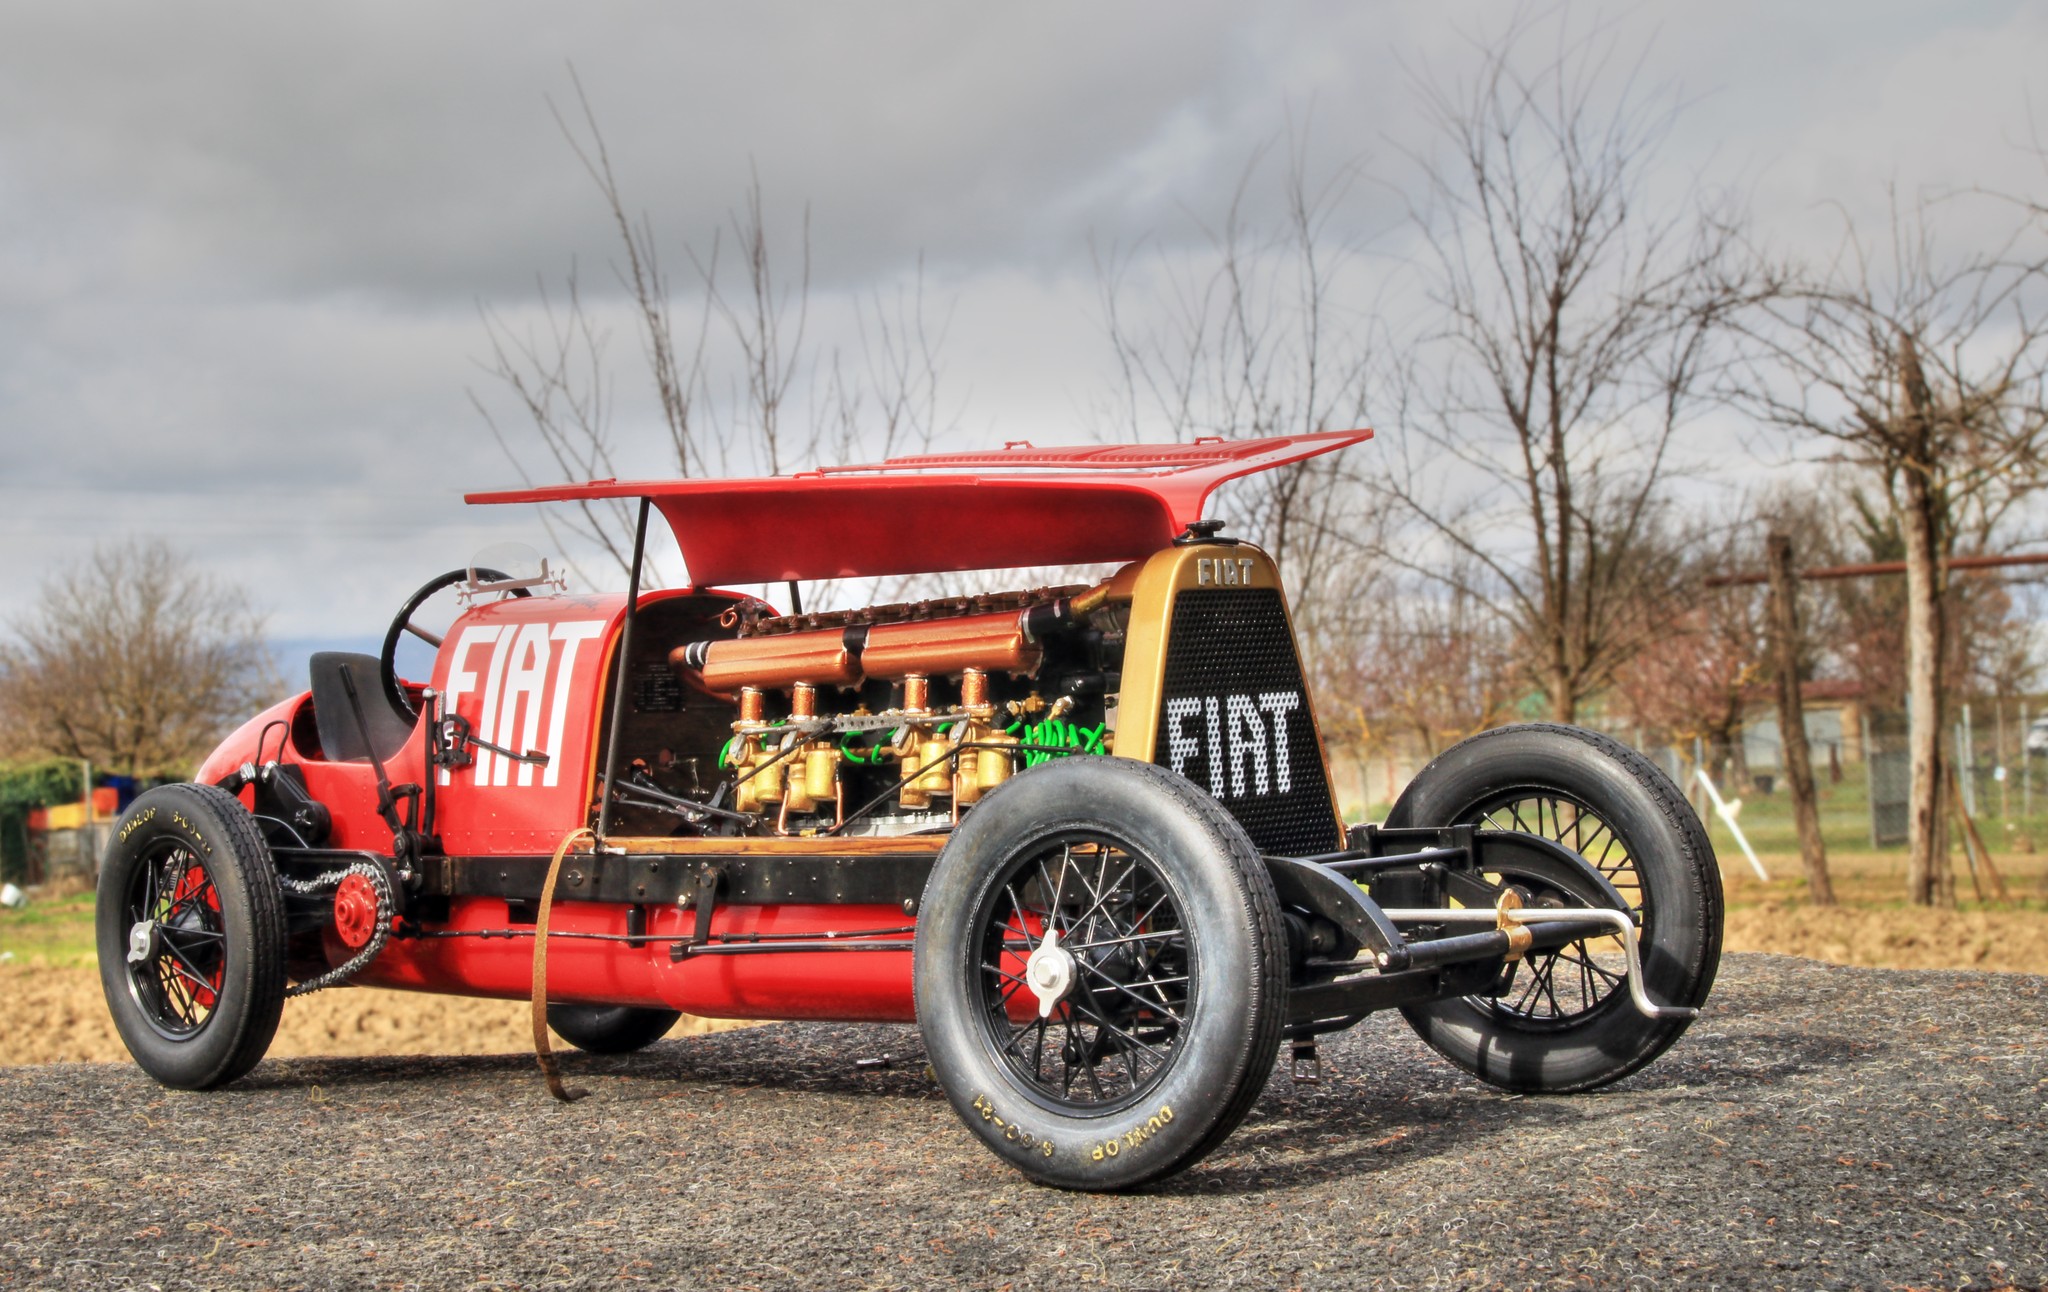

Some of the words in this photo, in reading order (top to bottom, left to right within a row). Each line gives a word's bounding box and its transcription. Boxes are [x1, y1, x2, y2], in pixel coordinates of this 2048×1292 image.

[1197, 558, 1254, 586] FIAT
[437, 620, 607, 787] FIAT
[1167, 691, 1299, 798] FIAT
[119, 807, 156, 842] DUNLOP
[1091, 1105, 1174, 1161] DUNLOP
